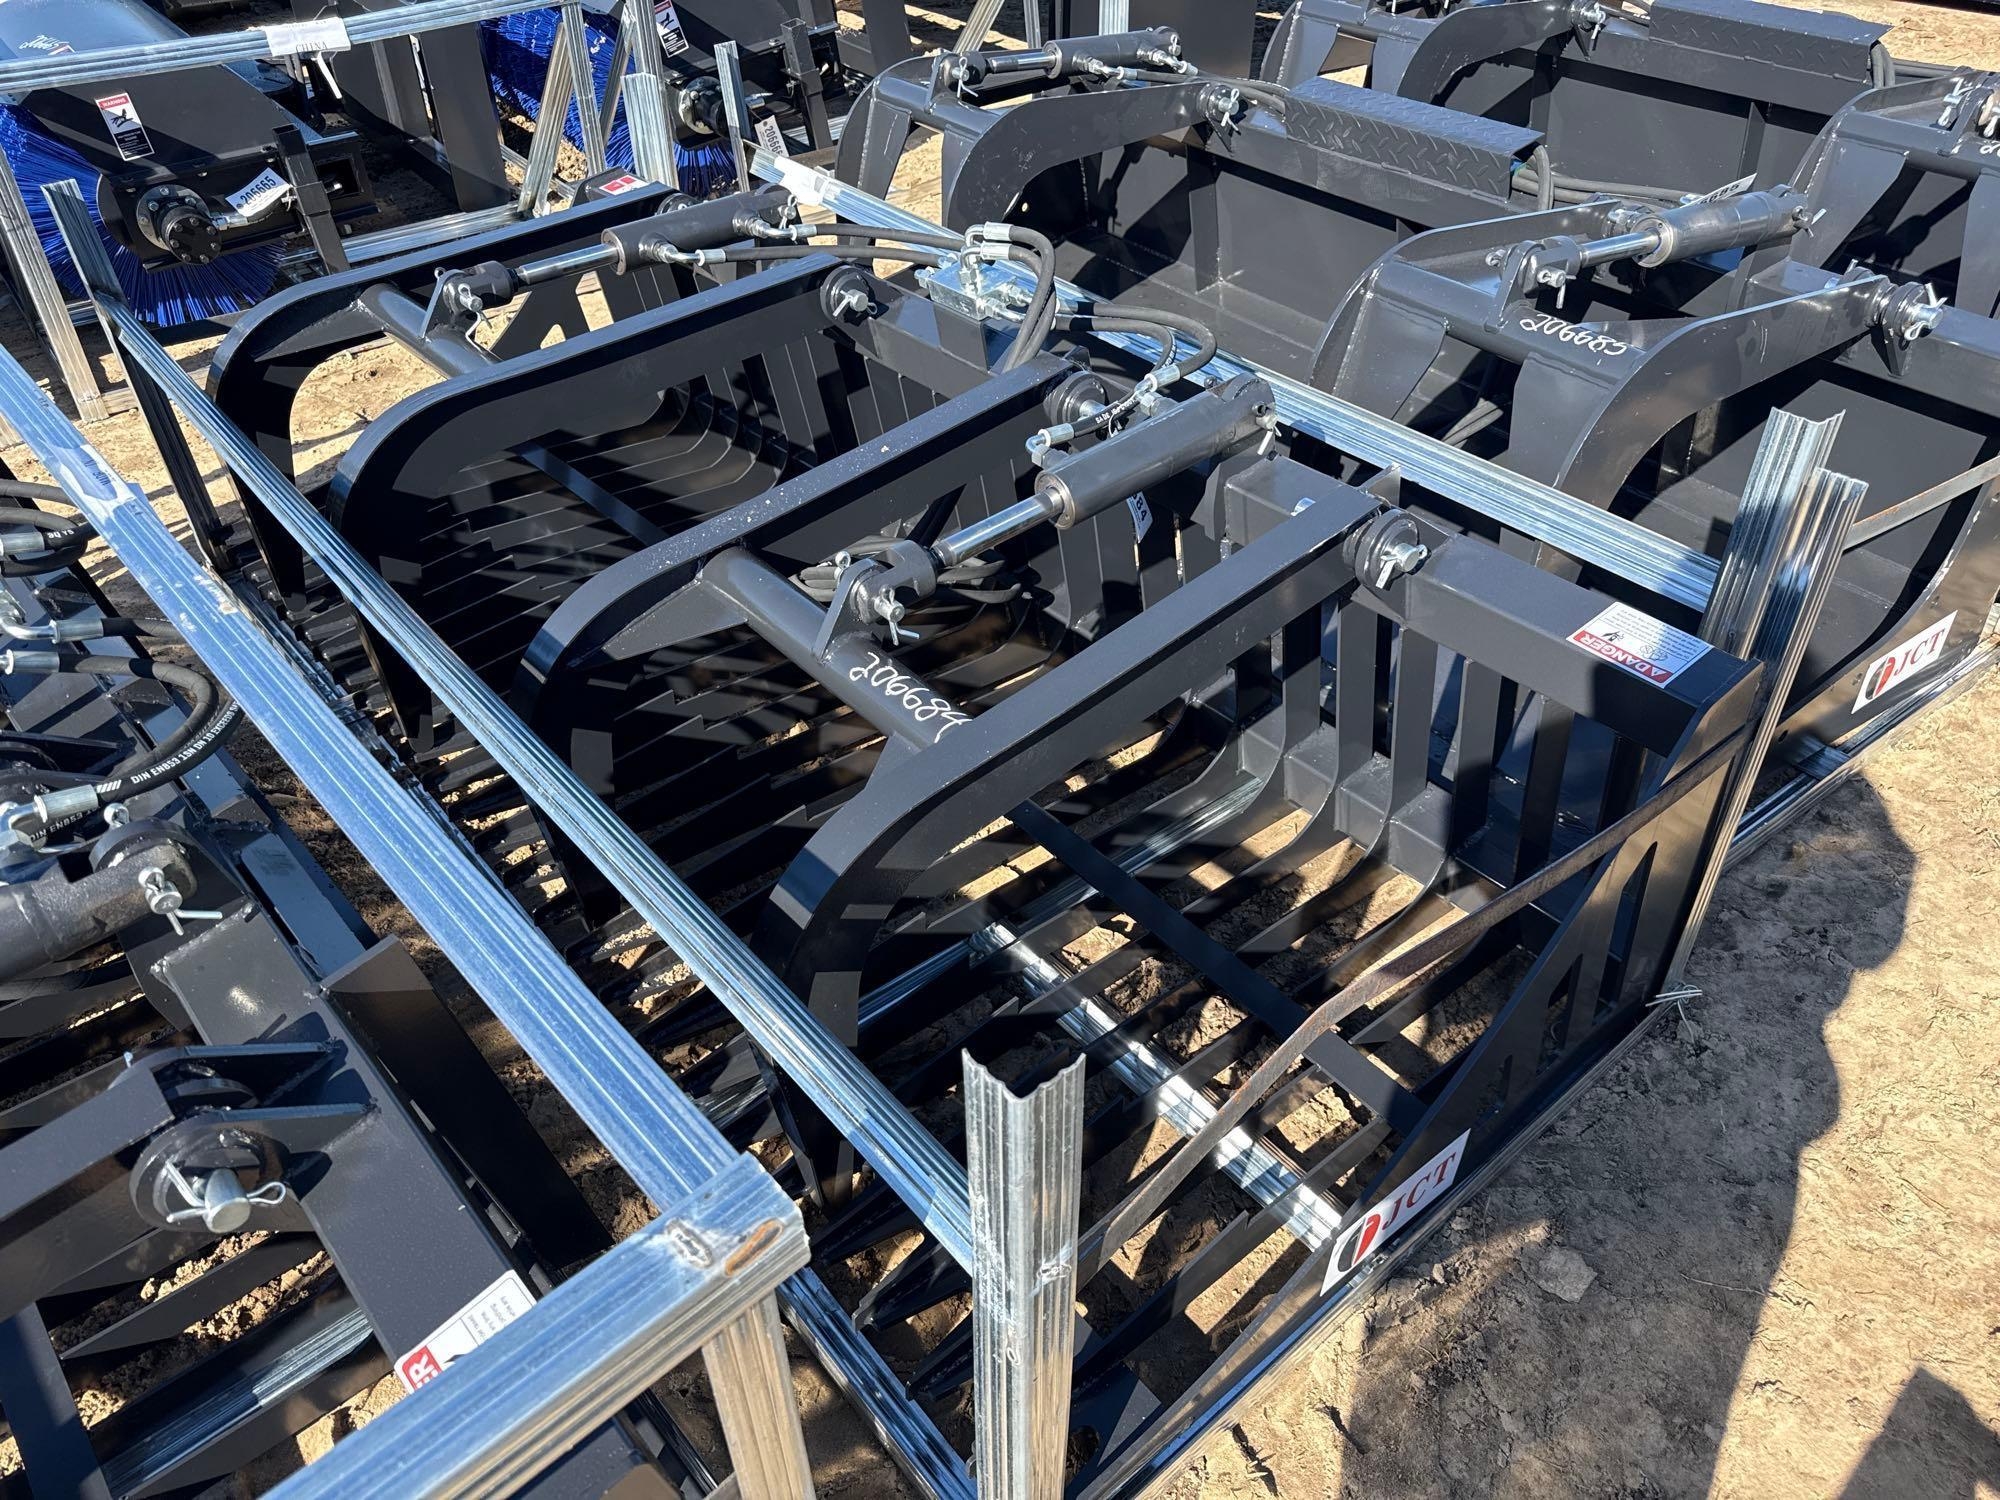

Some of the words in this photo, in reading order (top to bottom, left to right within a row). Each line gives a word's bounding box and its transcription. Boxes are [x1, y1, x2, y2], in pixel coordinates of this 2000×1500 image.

[239, 175, 277, 206] 206665
[1519, 313, 1628, 356] 206685
[1580, 633, 1650, 673] DANGER
[1893, 628, 1945, 677] JCT
[849, 651, 974, 744] 206684
[130, 771, 152, 784] DIN
[150, 757, 181, 777] EN853
[178, 746, 197, 761] 1SN
[194, 739, 208, 751] DN
[202, 731, 215, 742] 10
[210, 710, 236, 735] EXCEEDS
[50, 811, 84, 834] EN853
[1382, 1151, 1457, 1231] JCT
